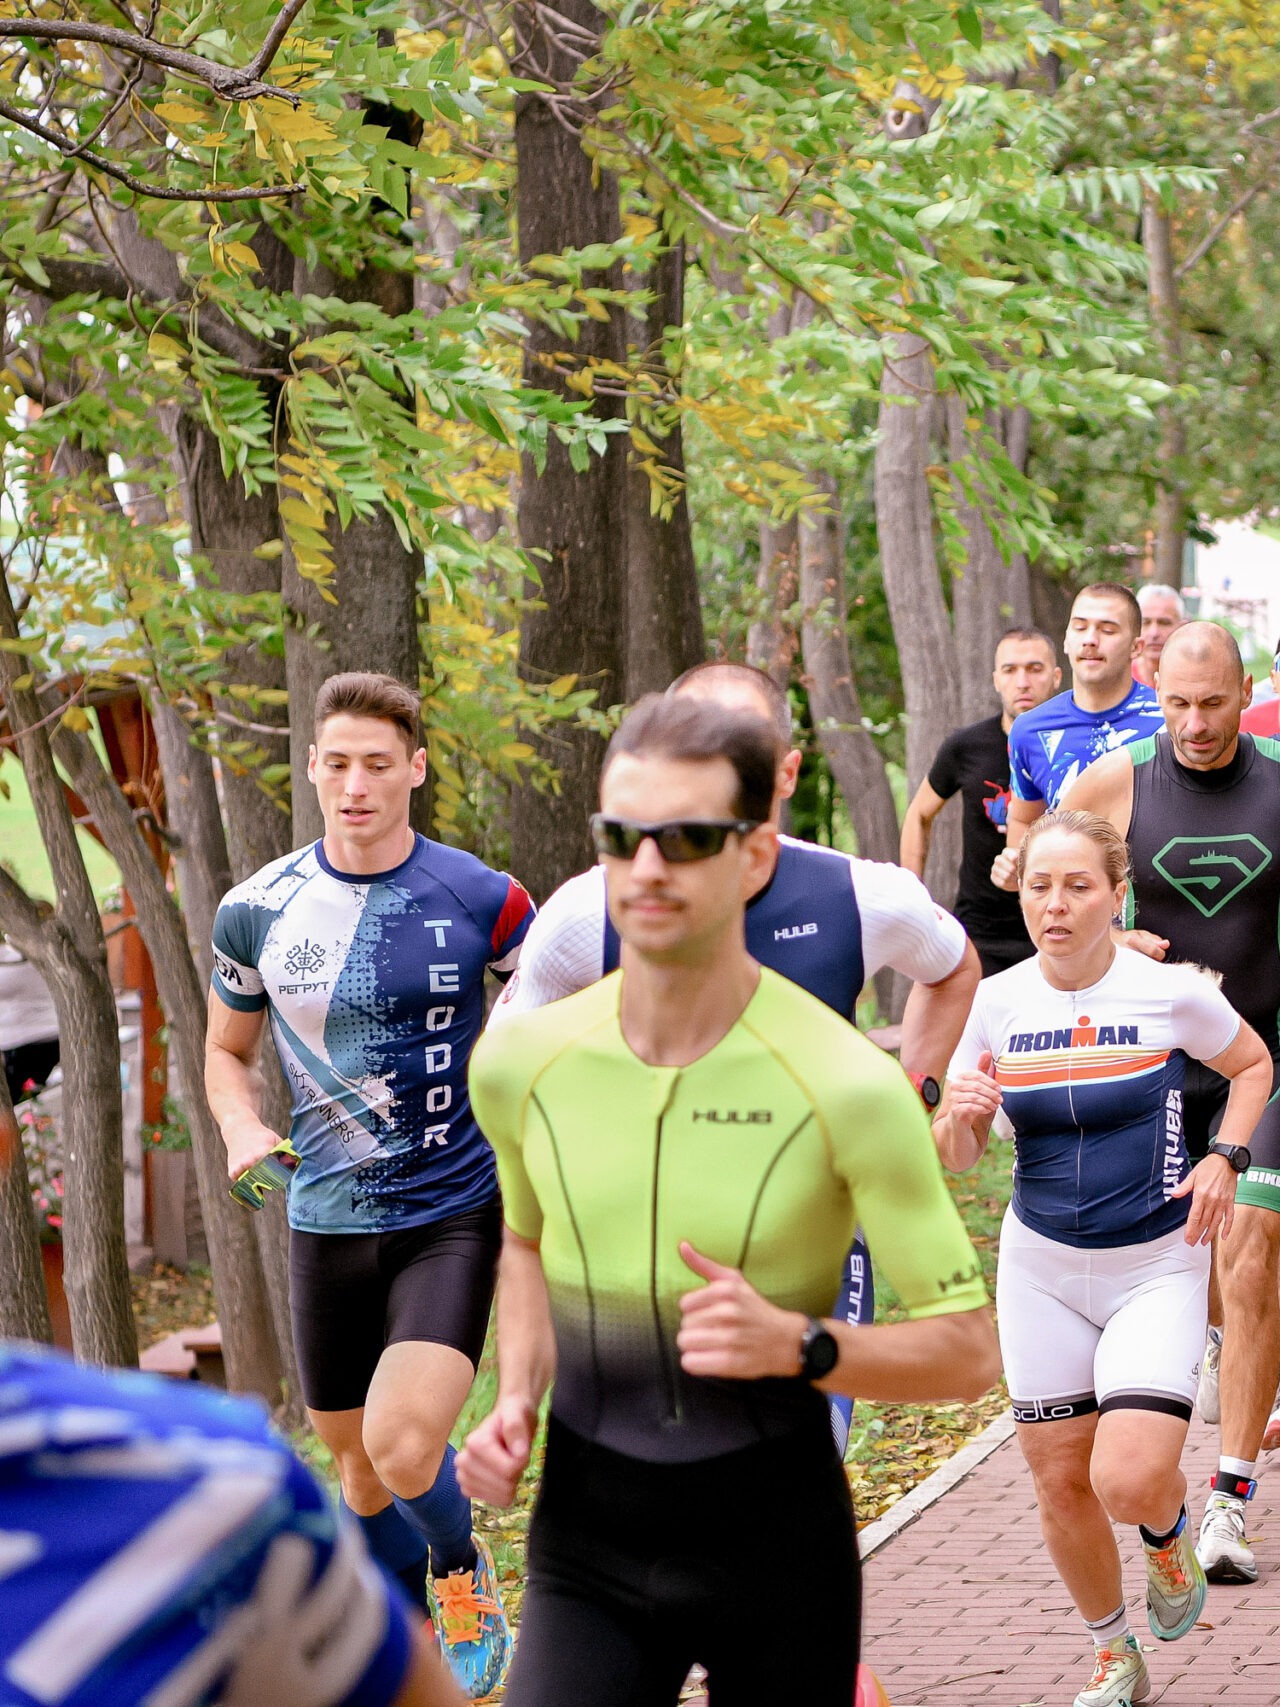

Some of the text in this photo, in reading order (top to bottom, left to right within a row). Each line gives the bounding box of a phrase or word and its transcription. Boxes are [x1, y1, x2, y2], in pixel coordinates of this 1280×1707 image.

[774, 922, 818, 941] HUUB
[422, 919, 459, 1148] TEODOR
[1008, 1016, 1142, 1053] IRONMAN
[692, 1109, 772, 1124] HUUB
